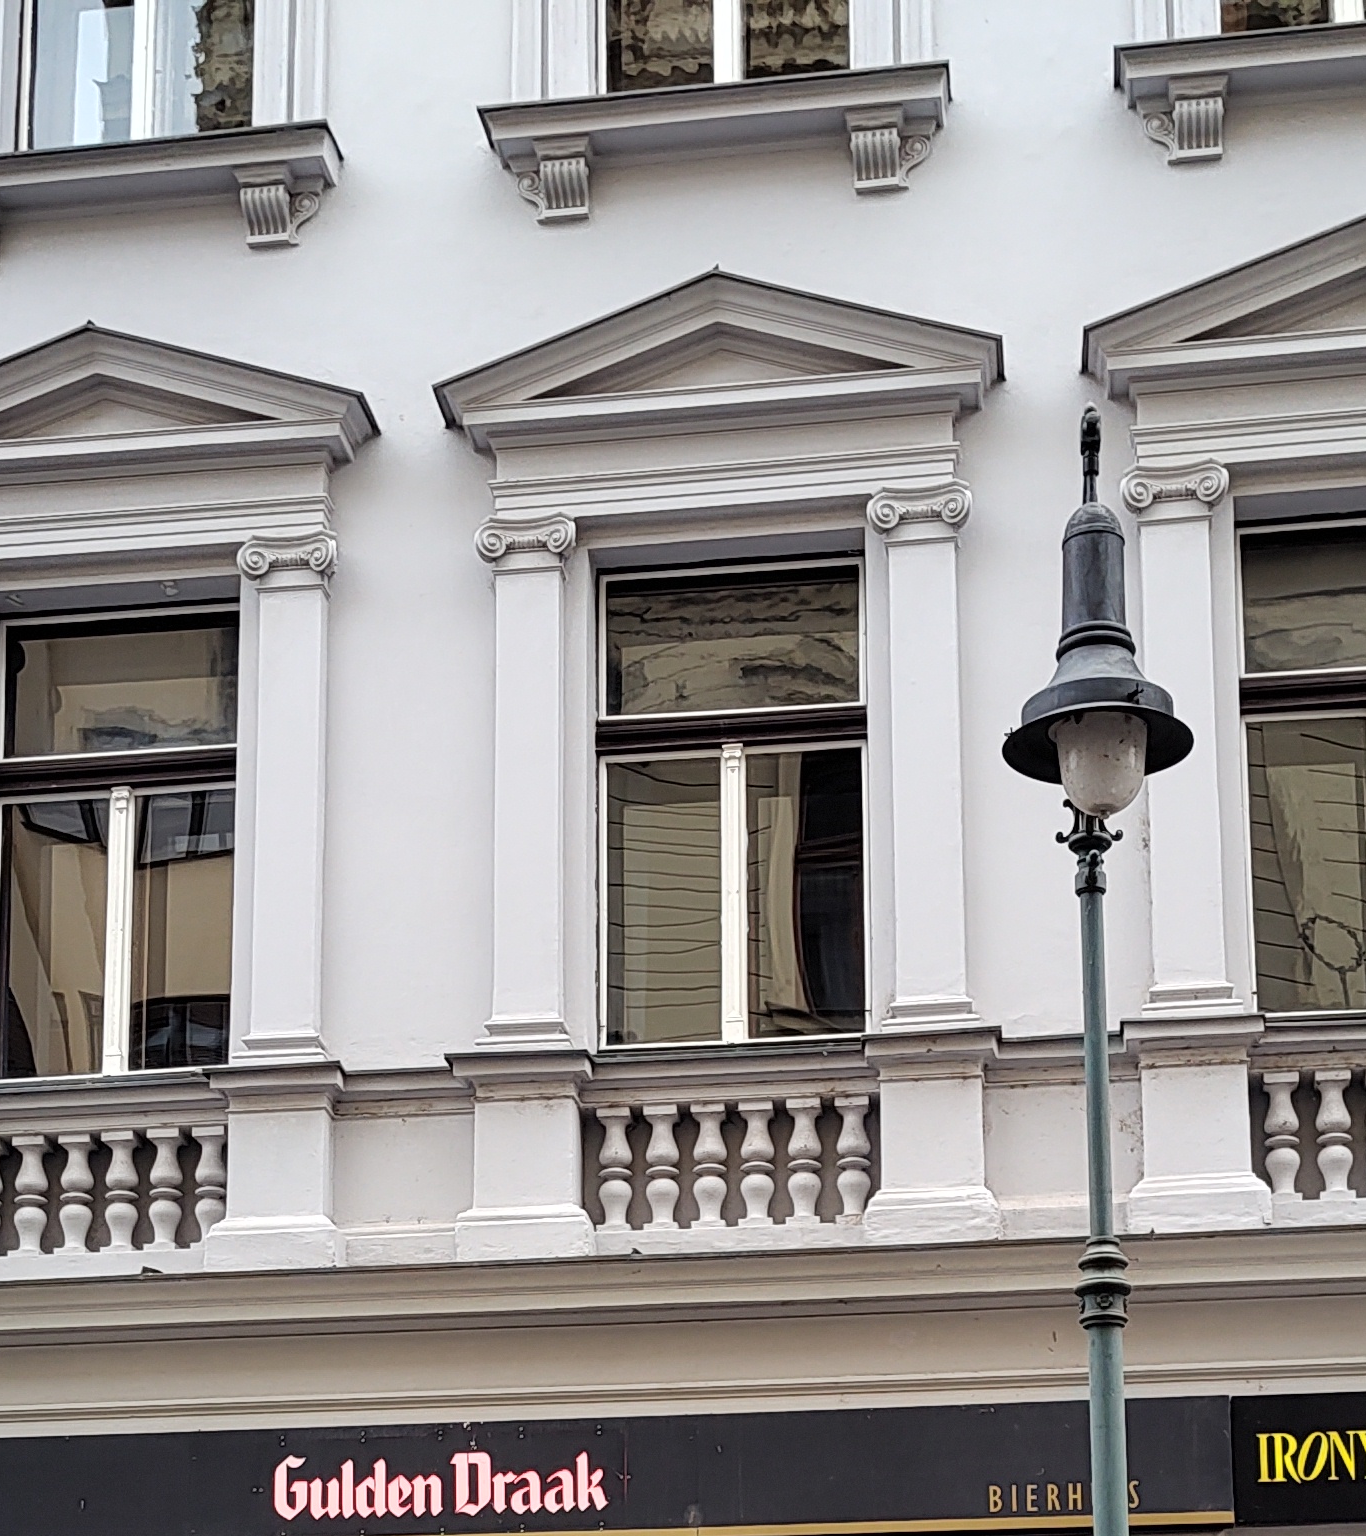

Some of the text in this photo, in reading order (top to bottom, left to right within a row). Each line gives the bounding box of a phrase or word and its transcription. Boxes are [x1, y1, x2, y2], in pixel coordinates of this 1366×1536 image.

[273, 1451, 609, 1521] Gulden Draak
[988, 1480, 1140, 1513] BIERHS
